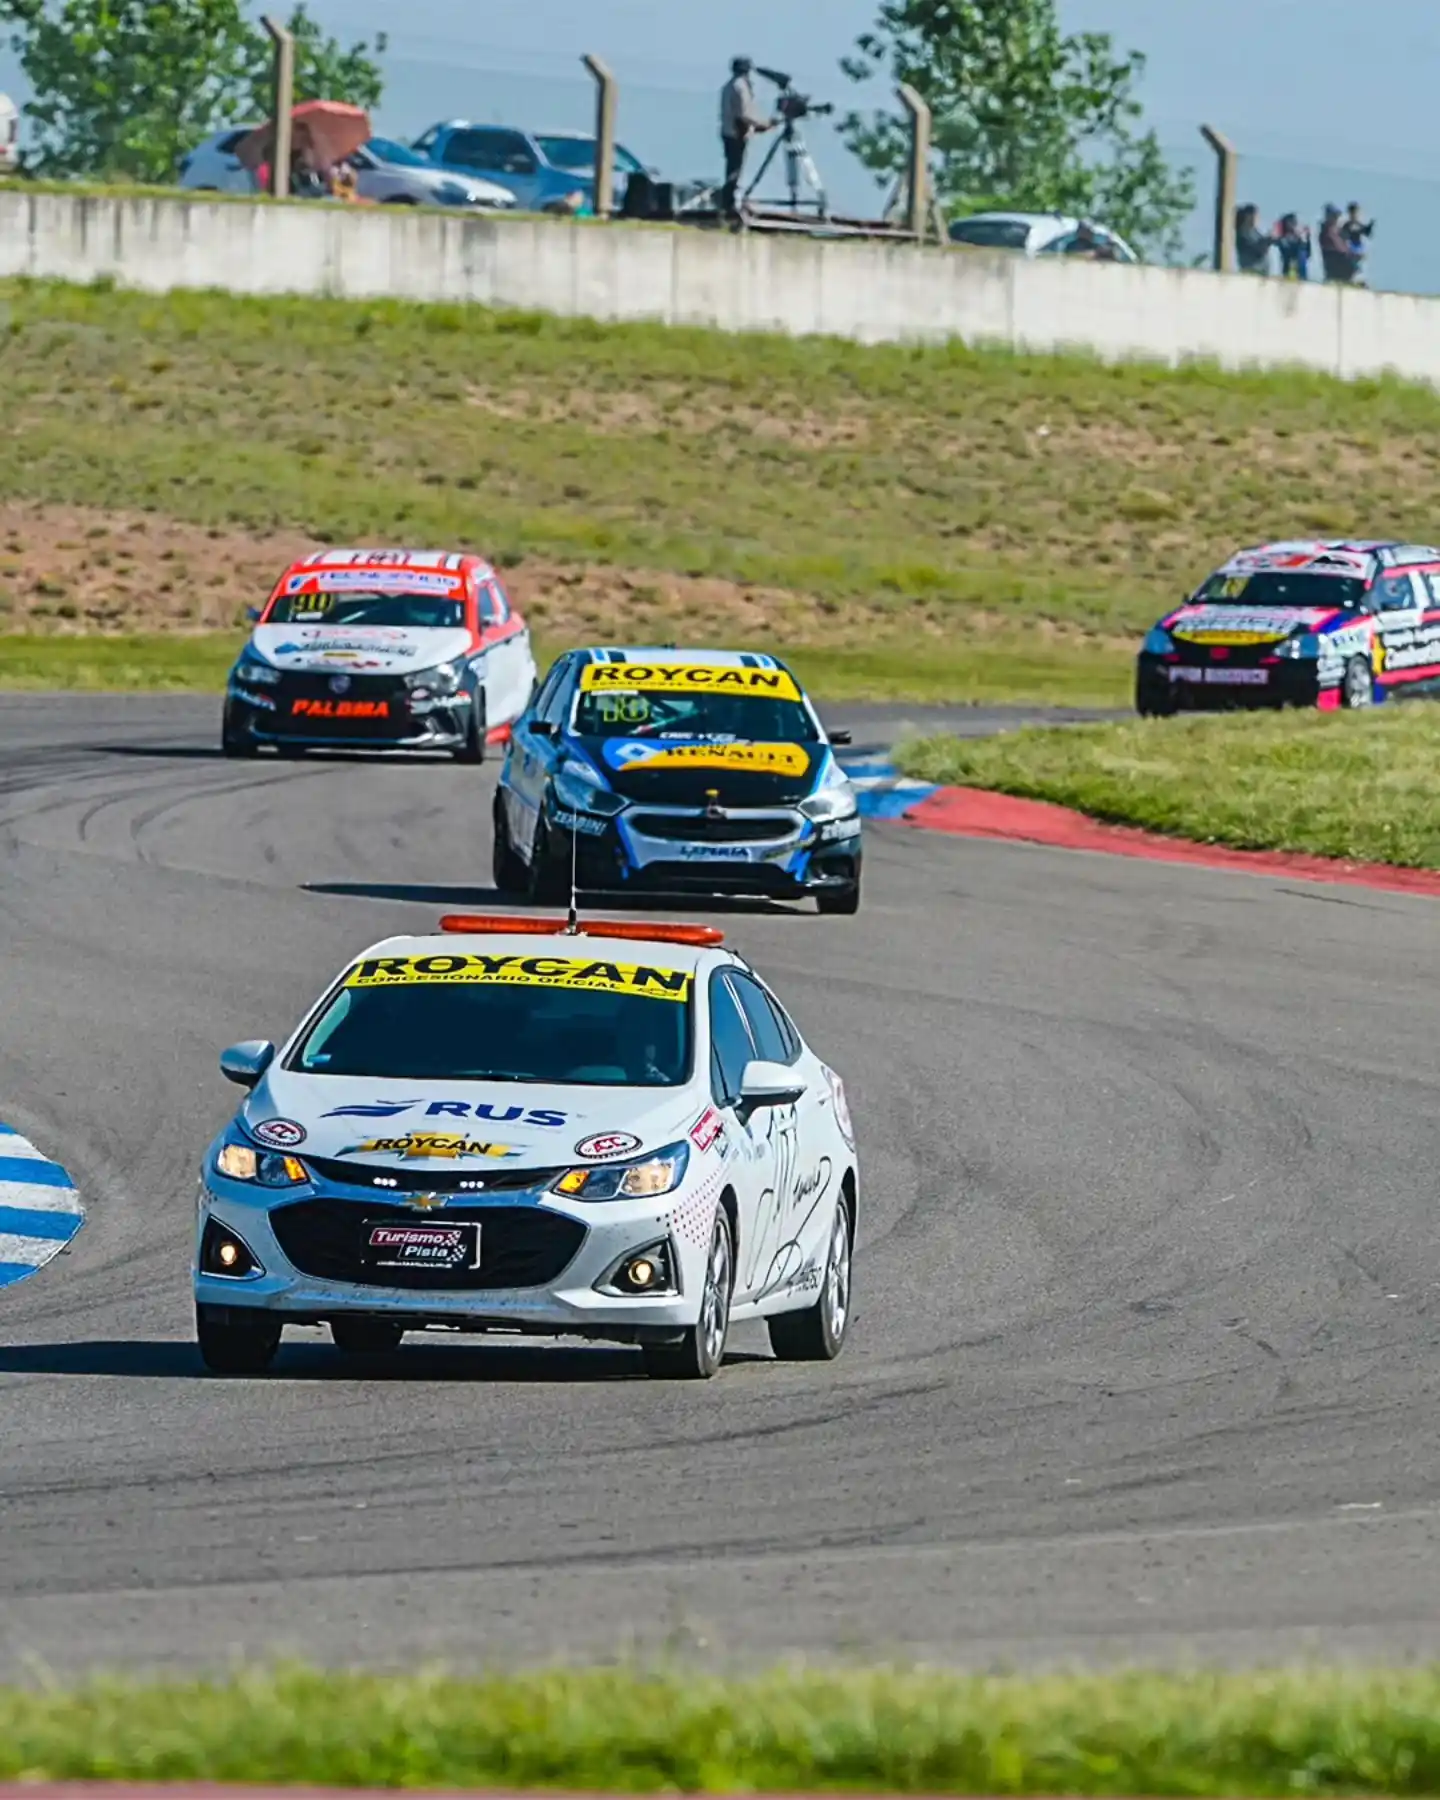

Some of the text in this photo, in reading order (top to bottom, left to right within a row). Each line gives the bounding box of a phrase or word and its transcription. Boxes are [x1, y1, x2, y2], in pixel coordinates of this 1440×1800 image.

[592, 667, 780, 688] ROYCAN
[292, 699, 389, 718] PALOMA
[357, 974, 621, 990] CONCESIONARIO OFICIAL
[358, 955, 687, 991] ROYCAN
[425, 1101, 568, 1127] RUS
[372, 1136, 493, 1155] ROYCAN
[376, 1231, 445, 1244] Turismo
[404, 1245, 448, 1258] Pista
